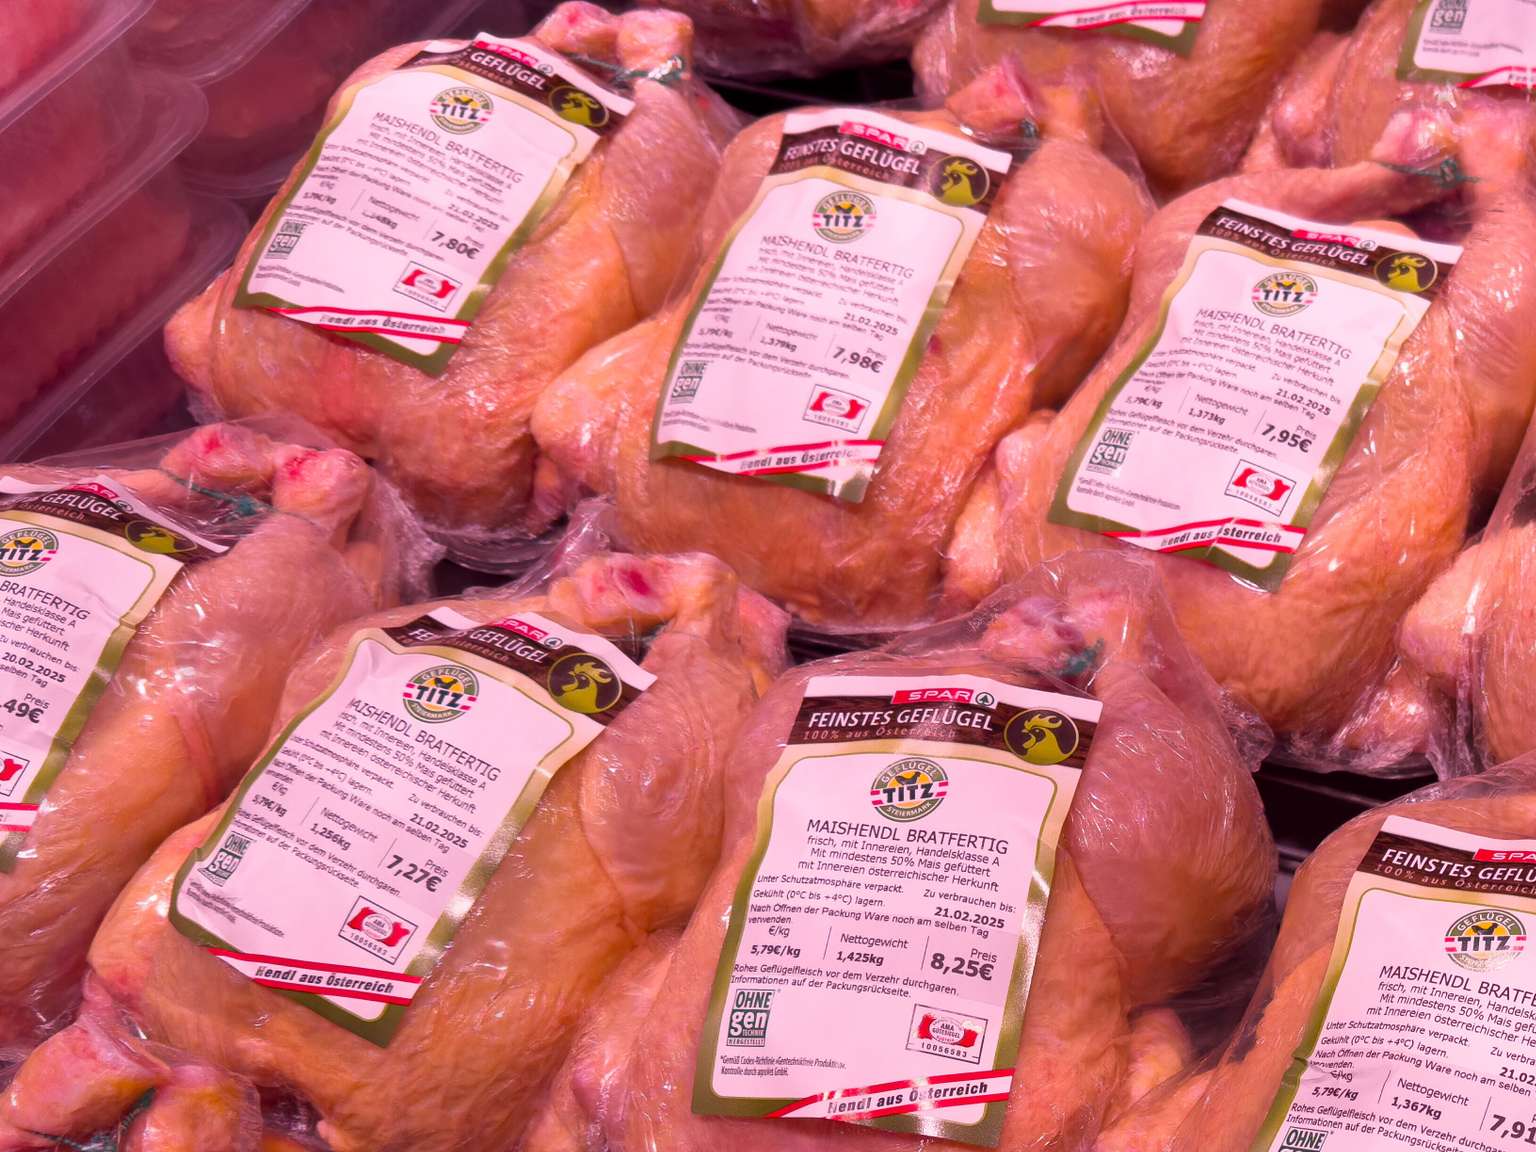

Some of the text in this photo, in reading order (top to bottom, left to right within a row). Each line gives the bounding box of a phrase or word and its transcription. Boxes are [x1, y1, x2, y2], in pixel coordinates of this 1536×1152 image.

[41, 491, 121, 521] GEFLÜGEL
[0, 580, 91, 620] BRATFERTIG
[26, 626, 71, 652] Herkunft
[469, 627, 547, 664] GEFLÜGEL
[1, 651, 66, 684] 20.02.2025
[25, 691, 50, 709] Preis
[415, 684, 463, 710] TITZ
[808, 705, 993, 732] FEINSTES GEFLÜGEL
[414, 728, 502, 782] BRATFERTIG
[310, 822, 352, 852] 1,256kg
[408, 812, 469, 850] 21.02.2025
[806, 819, 1009, 855] MAISHENDL BRATFERTIG
[386, 854, 442, 893] 7,27€
[1382, 848, 1472, 878] FEINSTES
[934, 906, 1005, 929] 21.02.2025
[1457, 935, 1512, 952] TITZ
[835, 951, 884, 967] 1,425kg
[930, 952, 993, 981] 8,25€
[1391, 1095, 1442, 1120] 1,367kg
